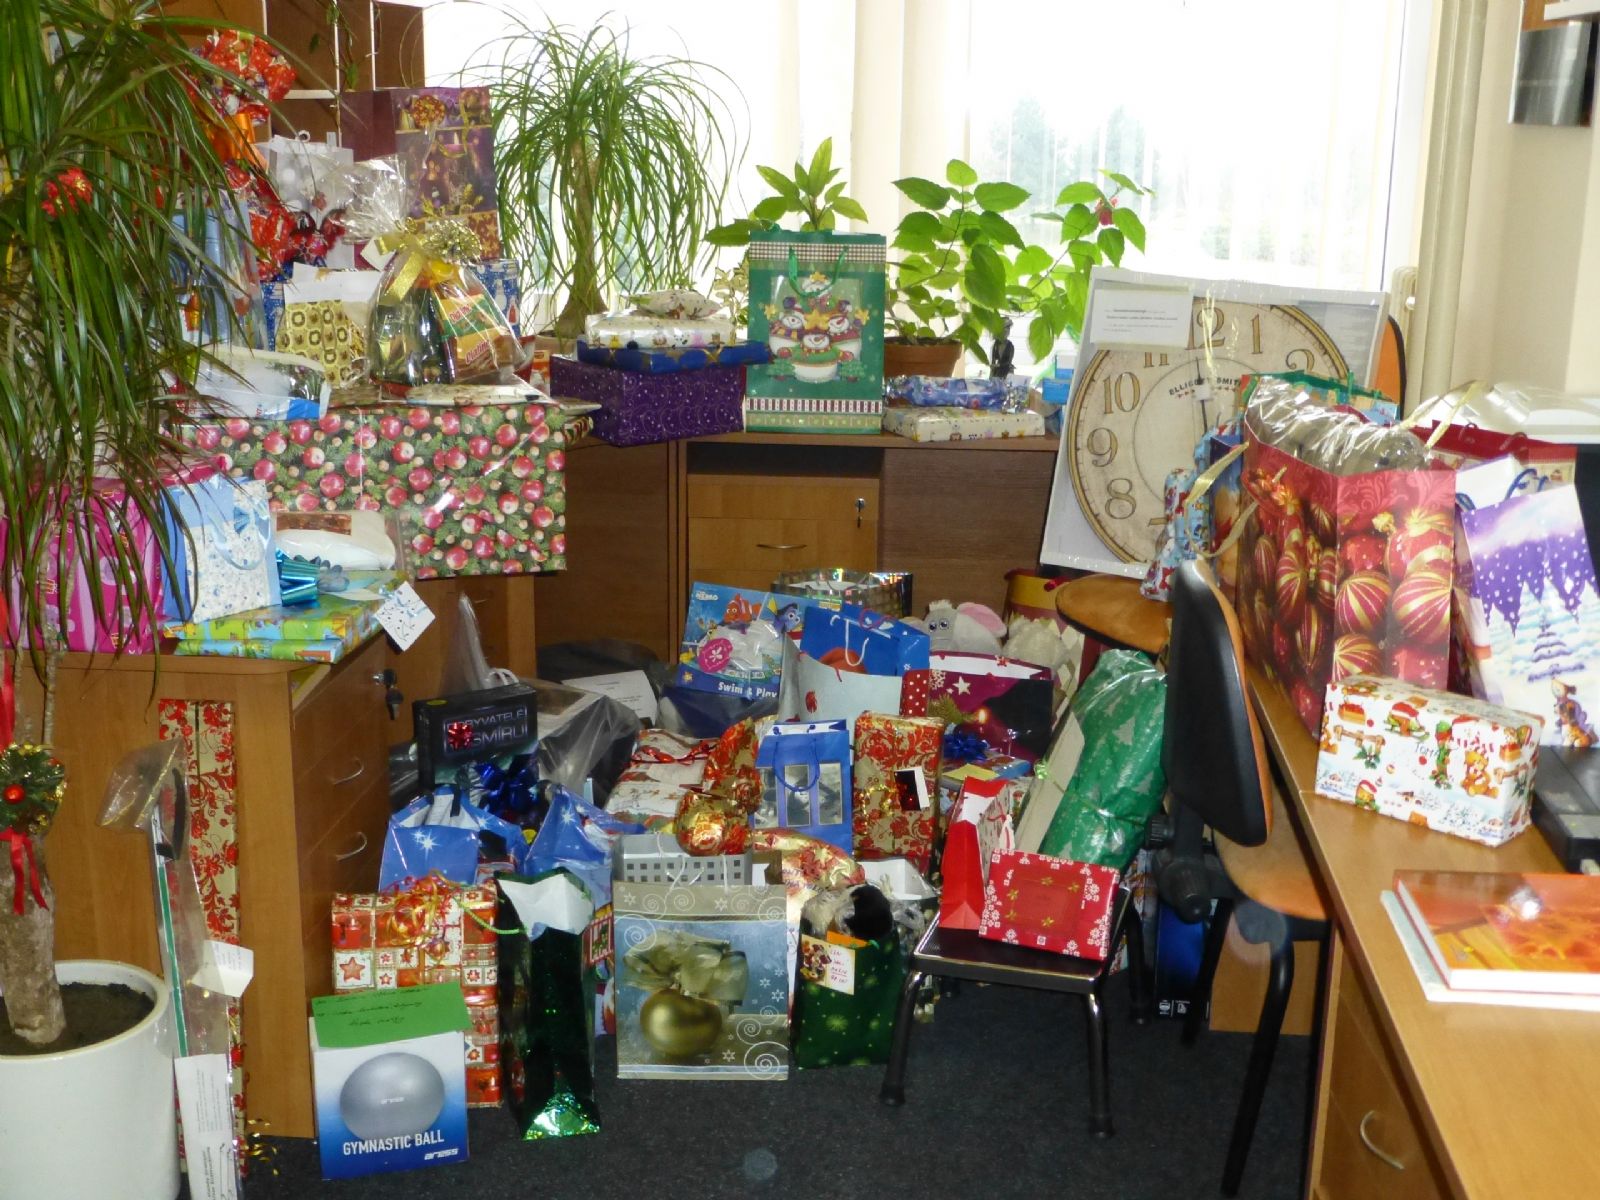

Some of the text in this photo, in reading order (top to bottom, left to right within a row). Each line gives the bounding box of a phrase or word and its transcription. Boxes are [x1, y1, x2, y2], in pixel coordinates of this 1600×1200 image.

[1250, 313, 1264, 354] 1
[1102, 371, 1141, 415] 10
[1087, 427, 1118, 467] 9
[1106, 478, 1137, 519] 8
[718, 682, 743, 694] Swim
[343, 1129, 444, 1156] GYMNASTIC BALL
